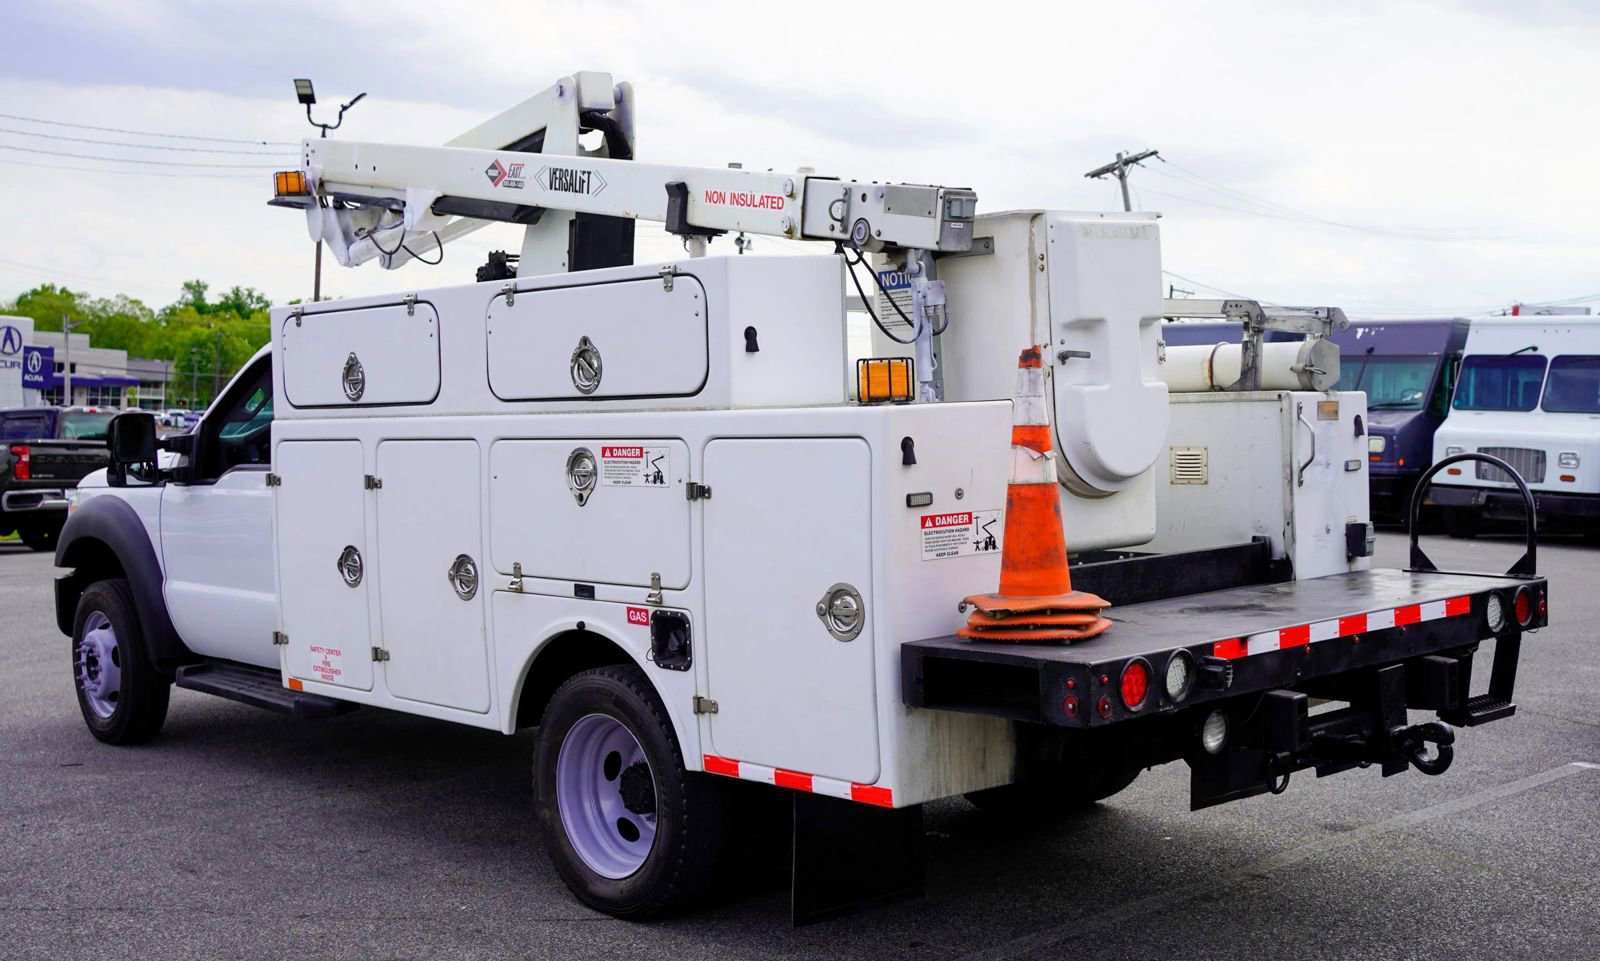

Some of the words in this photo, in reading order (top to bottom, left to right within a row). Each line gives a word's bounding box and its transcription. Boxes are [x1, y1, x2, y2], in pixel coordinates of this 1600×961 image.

[508, 163, 525, 178] EAST
[549, 167, 592, 194] VERSALIFT
[705, 190, 725, 204] NON
[729, 192, 784, 209] INSULATED
[24, 374, 44, 382] ACURA
[612, 448, 641, 457] DANGER
[935, 514, 969, 525] DANGER
[629, 610, 647, 622] GAS
